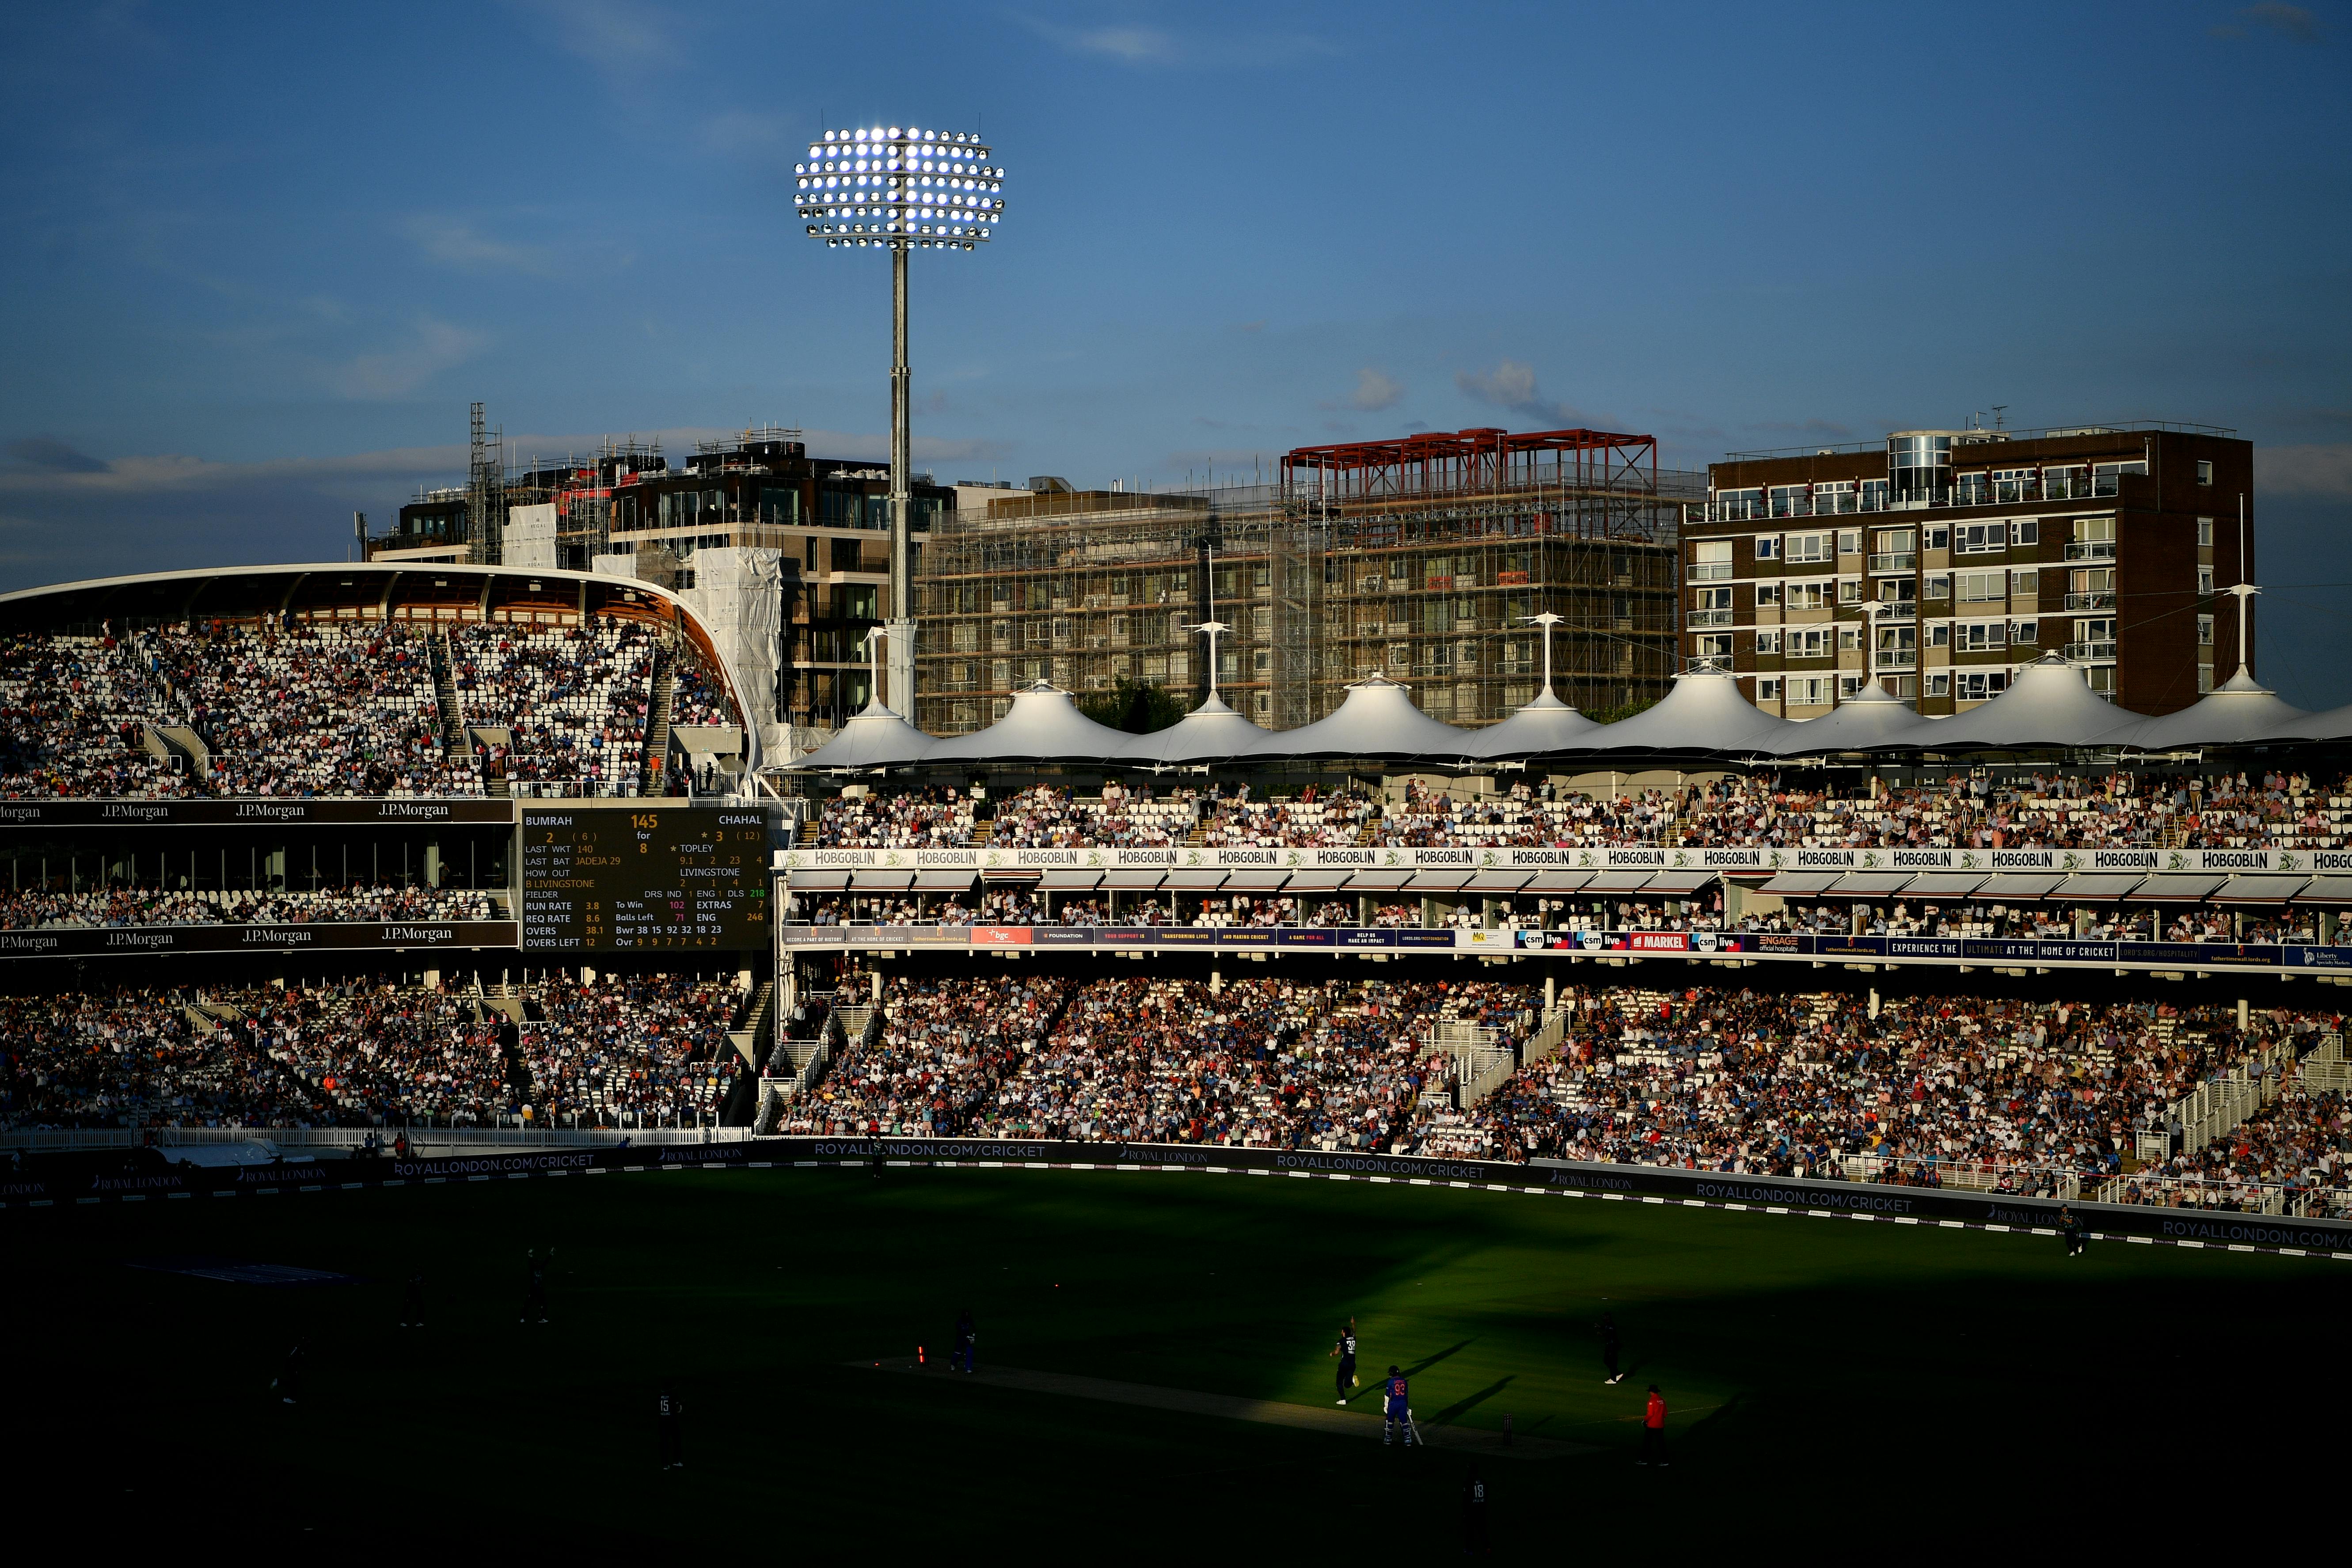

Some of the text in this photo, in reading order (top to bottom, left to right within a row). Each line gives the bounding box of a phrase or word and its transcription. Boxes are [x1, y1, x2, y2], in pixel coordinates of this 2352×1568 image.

[102, 805, 168, 820] J.P.Morgan
[236, 805, 304, 820] J.P.Morgan
[378, 804, 449, 820] J.P.Morgan
[525, 816, 573, 827] BUMRAH
[631, 815, 657, 828] 145
[718, 815, 762, 824] CHAHAL
[546, 832, 553, 843] 2
[636, 831, 650, 840] for
[716, 831, 722, 841] 3
[640, 843, 647, 854] 8
[680, 844, 713, 853] TOPLEY
[525, 856, 620, 866] LAST BAT JADEJA 29
[730, 855, 740, 864] 23
[816, 850, 874, 866] HOBGOBLIN
[917, 851, 976, 864] HOBGOBLIN
[1018, 851, 1077, 864] HOBGOBLIN
[1119, 850, 1177, 865] HOBGOBLIN
[1219, 850, 1276, 864] HOBGOBLIN
[1318, 850, 1375, 864] HOBGOBLIN
[1416, 850, 1472, 863] HOBGOBLIN
[1513, 850, 1569, 864] HOBGOBLIN
[1609, 851, 1664, 865] HOBGOBLIN
[1705, 851, 1759, 865] HOBGOBLIN
[1799, 851, 1854, 866] HOBGOBLIN
[1894, 851, 1951, 866] HOBGOBLIN
[1992, 852, 2052, 867] HOBGOBLIN
[2096, 852, 2157, 869] HOBGOBLIN
[2203, 852, 2267, 868] HOBGOBLIN
[680, 867, 740, 877] LIVINGSTONE
[534, 879, 594, 888] LIVINGSTONE
[526, 890, 559, 899] FIELDER
[696, 889, 715, 898] ENG
[727, 889, 745, 898] DLS
[749, 889, 765, 898] 218
[525, 902, 546, 911] RUN
[548, 901, 572, 911] RATE
[669, 900, 684, 910] 102
[696, 900, 731, 909] EXTRAS
[525, 914, 545, 924] REQ
[547, 914, 570, 923] RATE
[637, 913, 654, 921] Left
[675, 912, 684, 922] 71
[696, 913, 715, 922] ENG
[382, 927, 452, 942] J.P.Morgan
[525, 926, 557, 935] OVERS
[995, 931, 1008, 940] bgc
[106, 933, 173, 948] J.P.Morgan
[245, 930, 311, 945] J.P.Morgan
[525, 938, 595, 947] OVERS LEFT 12
[1547, 934, 1562, 943] live
[1605, 935, 1620, 944] live
[1644, 936, 1683, 948] MARKEL
[1719, 938, 1734, 946] live
[1759, 936, 1798, 945] ENGAGE
[1892, 944, 1957, 953] EXPERIENCE THE
[1967, 945, 2033, 955] ULTIMATE AT THE
[2042, 947, 2113, 957] HOME OF CRICKET
[667, 1147, 742, 1162] ROYAL LONDON
[1128, 1150, 1208, 1163] ROYAL LONDON
[395, 1154, 594, 1176] ROYALLONDON.COM/CRICKET
[616, 925, 1355, 1411] Bwr 38 15 92 32 18 23
[1277, 1155, 1485, 1179] ROYALLONDON.COM/CRICKET
[1559, 1174, 1632, 1190] ROYAL LONDON
[1697, 1184, 1912, 1212] ROYALLONDON.COM/CRICKET
[1998, 1210, 2032, 1224] ROYAL
[1346, 1340, 1355, 1351] 38
[1395, 1384, 1405, 1396] 93
[660, 1400, 669, 1411] 15
[1474, 1484, 1484, 1497] 18
